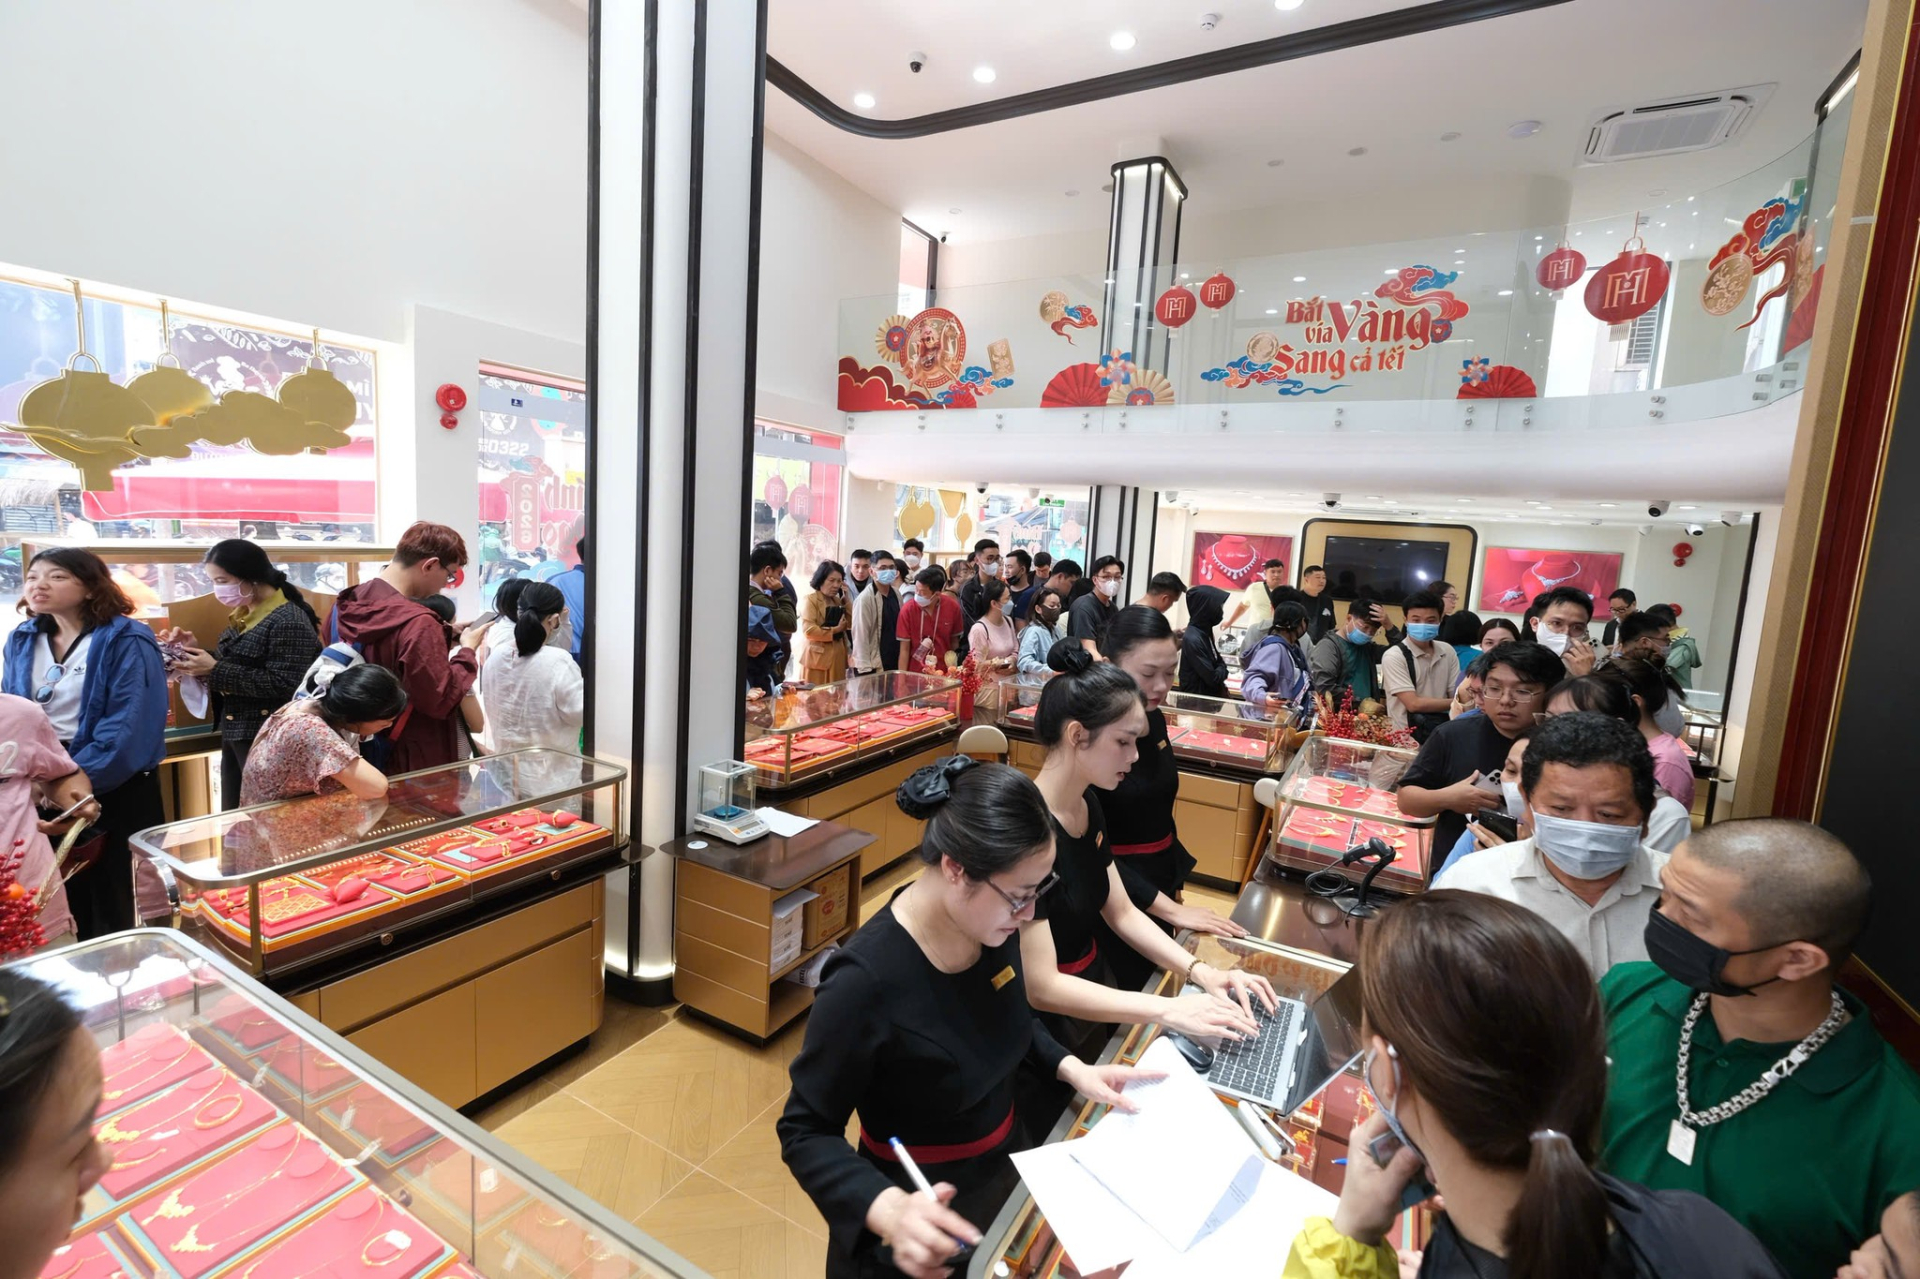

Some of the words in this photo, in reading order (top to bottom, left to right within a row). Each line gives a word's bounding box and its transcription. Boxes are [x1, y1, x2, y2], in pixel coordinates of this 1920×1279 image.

[1285, 294, 1324, 324] Bắt
[1305, 321, 1334, 344] vía
[1326, 299, 1432, 351] Vàng
[1270, 343, 1346, 380] Sang
[1349, 346, 1373, 373] cả
[1378, 344, 1407, 372] tết
